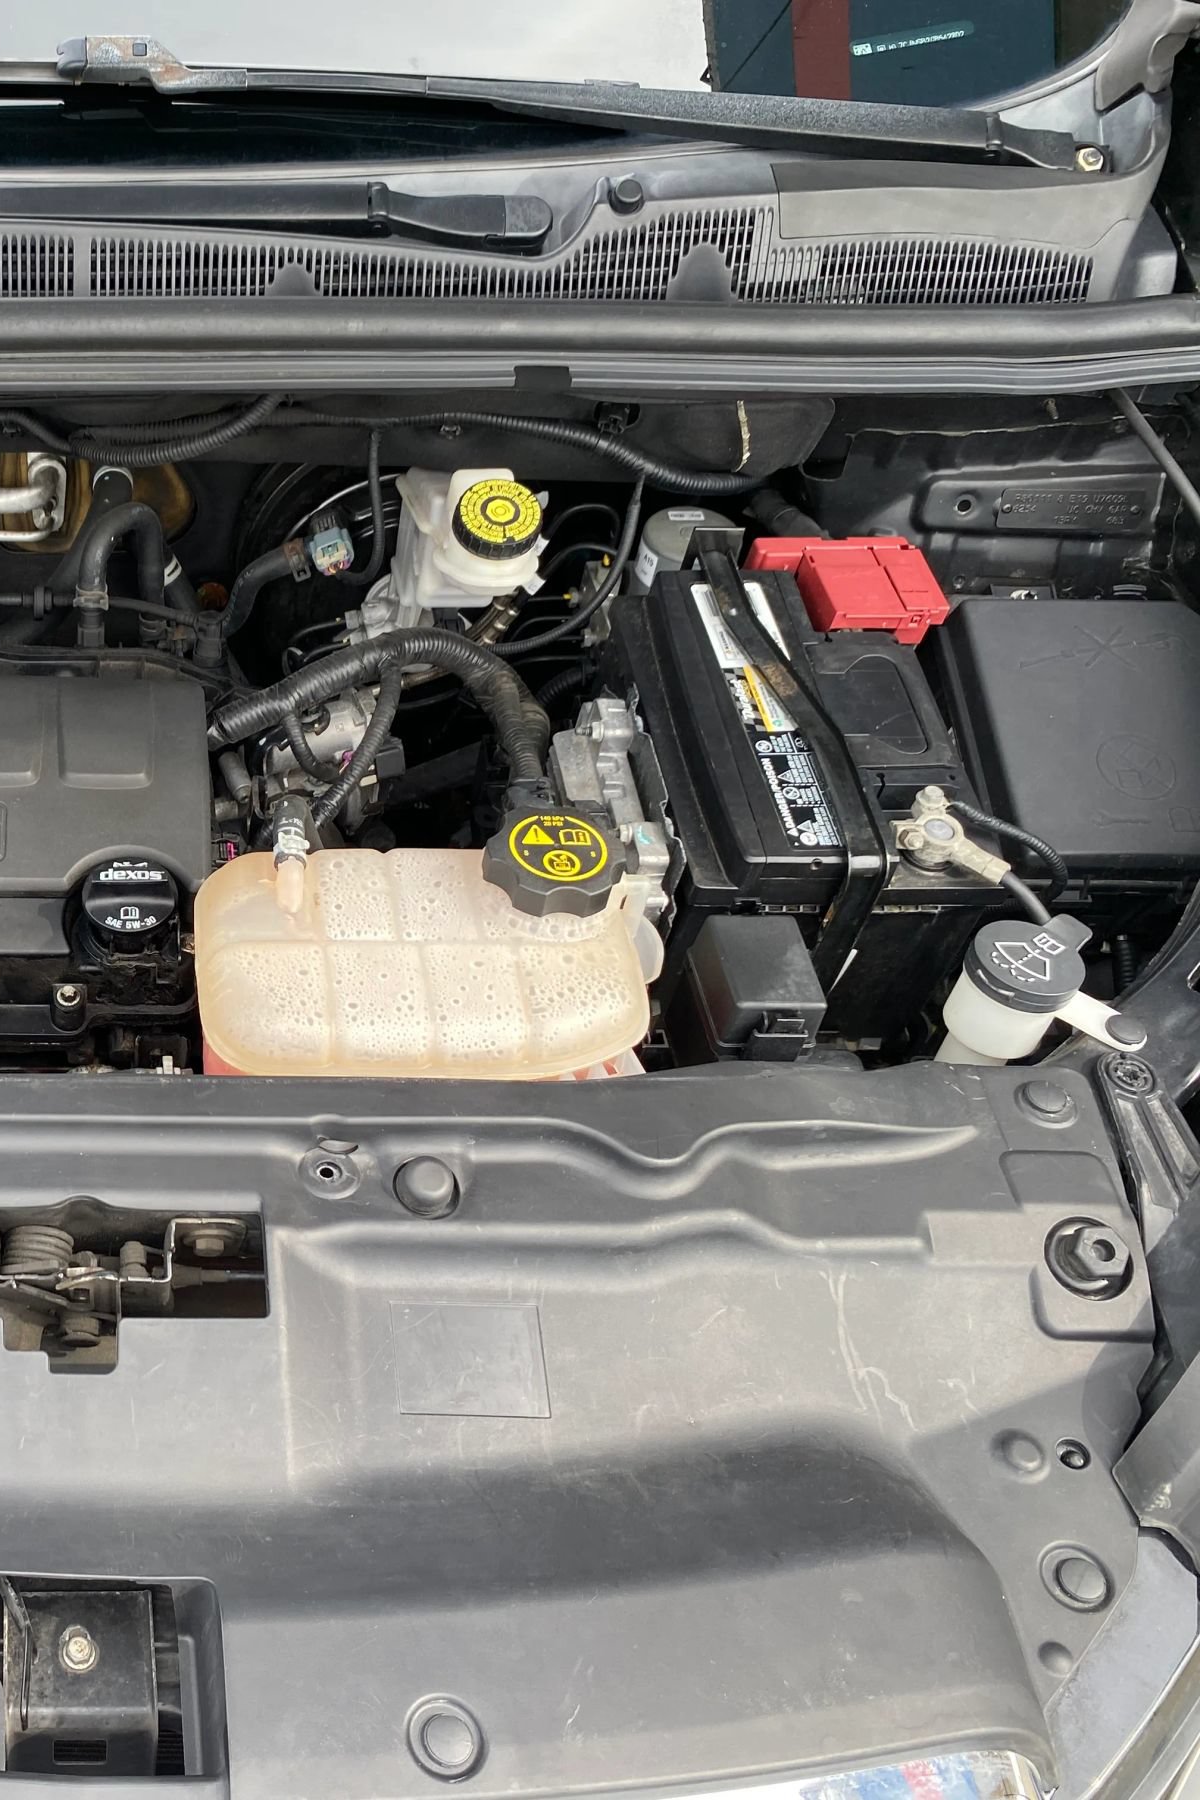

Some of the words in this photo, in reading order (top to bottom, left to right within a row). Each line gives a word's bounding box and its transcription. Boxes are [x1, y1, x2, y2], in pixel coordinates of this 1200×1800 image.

[730, 678, 756, 720] Duralast
[100, 868, 163, 881] dexos
[105, 916, 123, 929] SAE
[125, 915, 157, 929] 5W-30
